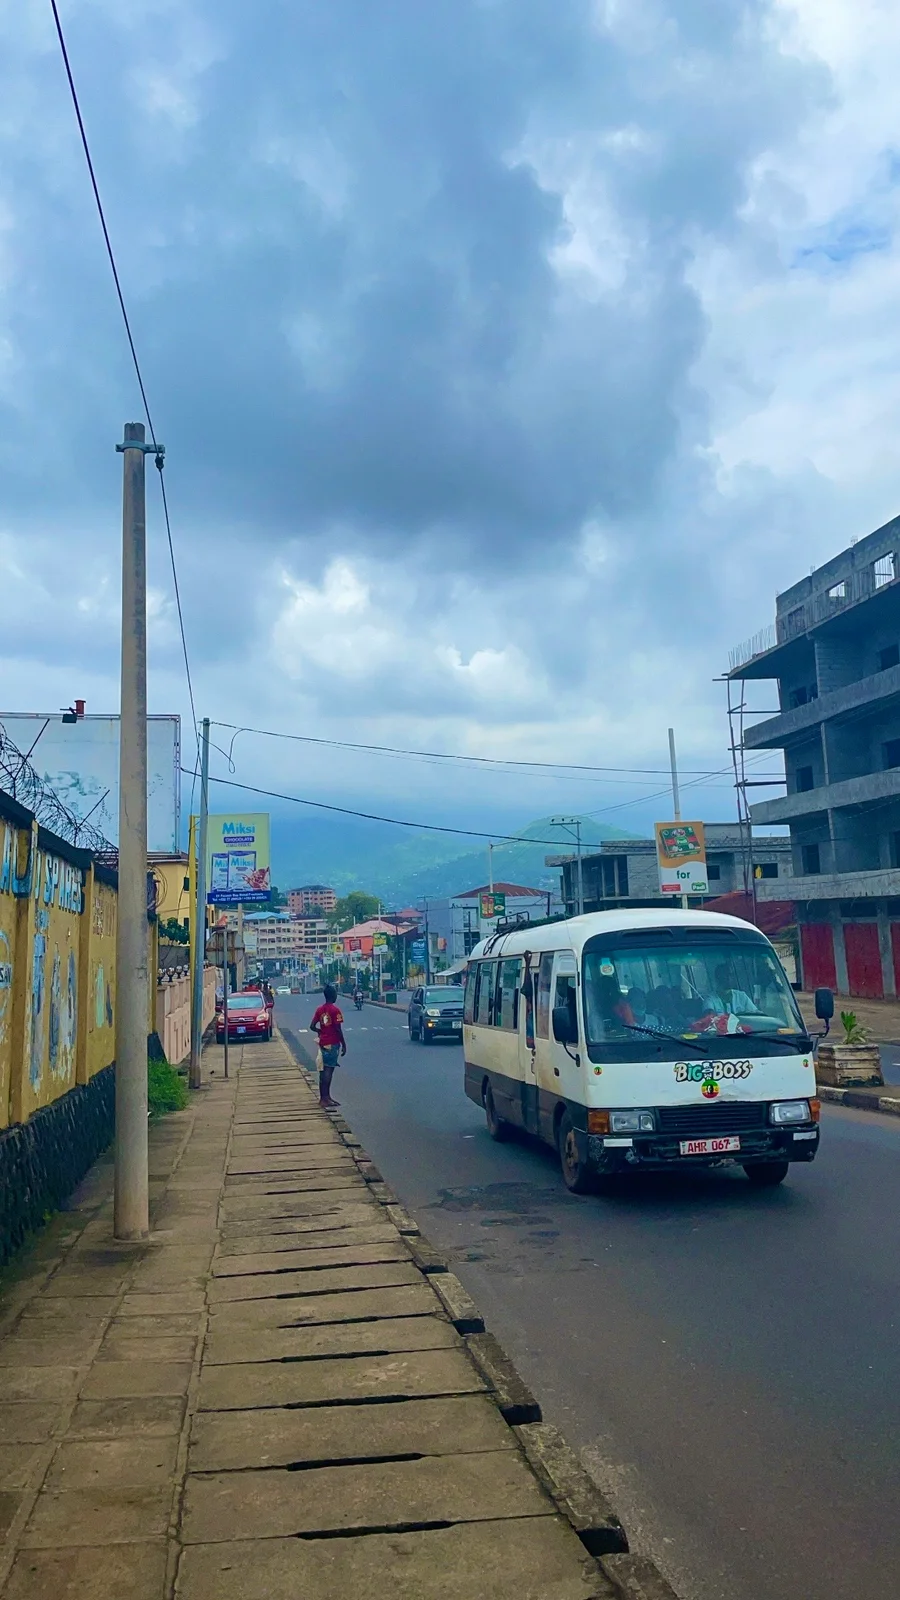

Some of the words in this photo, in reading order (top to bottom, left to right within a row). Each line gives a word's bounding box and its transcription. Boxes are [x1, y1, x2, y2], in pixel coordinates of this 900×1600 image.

[222, 822, 255, 834] Miksi
[676, 870, 691, 879] for
[712, 1061, 751, 1081] BOSS
[688, 1142, 707, 1153] AHR
[711, 1139, 730, 1151] 067
